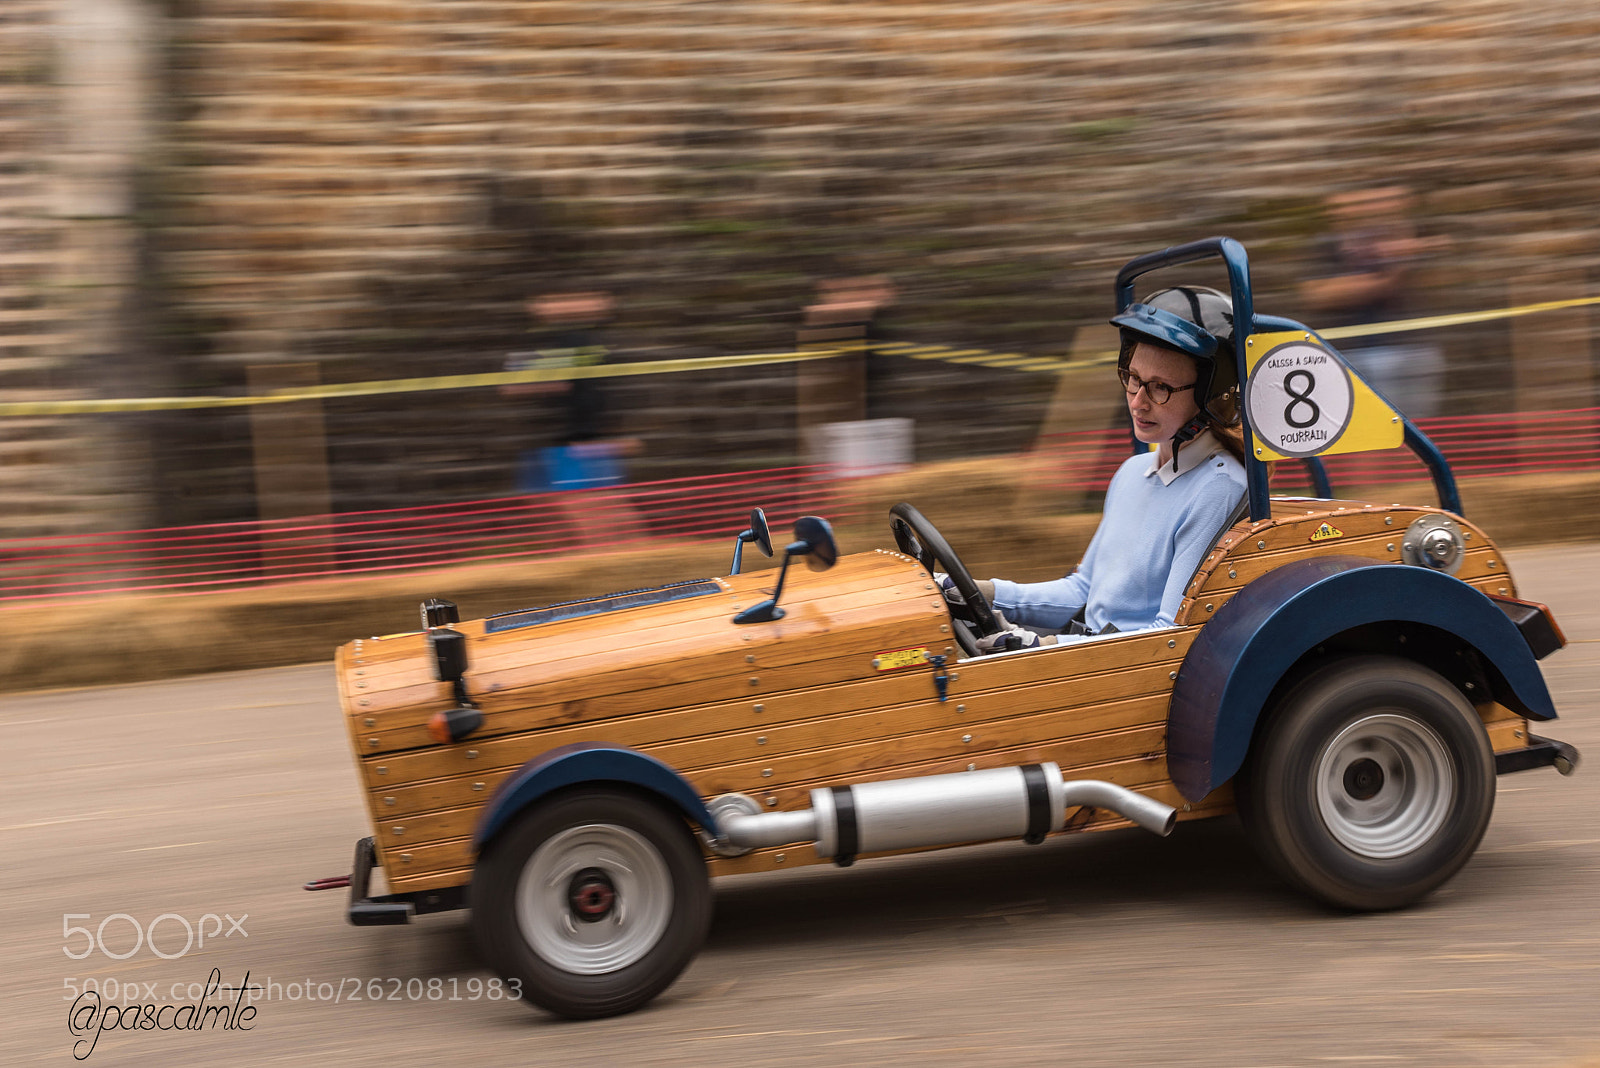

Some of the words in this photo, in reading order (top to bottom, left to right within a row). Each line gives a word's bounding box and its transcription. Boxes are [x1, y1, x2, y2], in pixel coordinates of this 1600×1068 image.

[1267, 358, 1294, 369] CAISSE
[1295, 357, 1301, 366] A
[1303, 356, 1327, 366] SAVON
[1283, 369, 1320, 429] 8
[1280, 430, 1328, 446] POURRAIN
